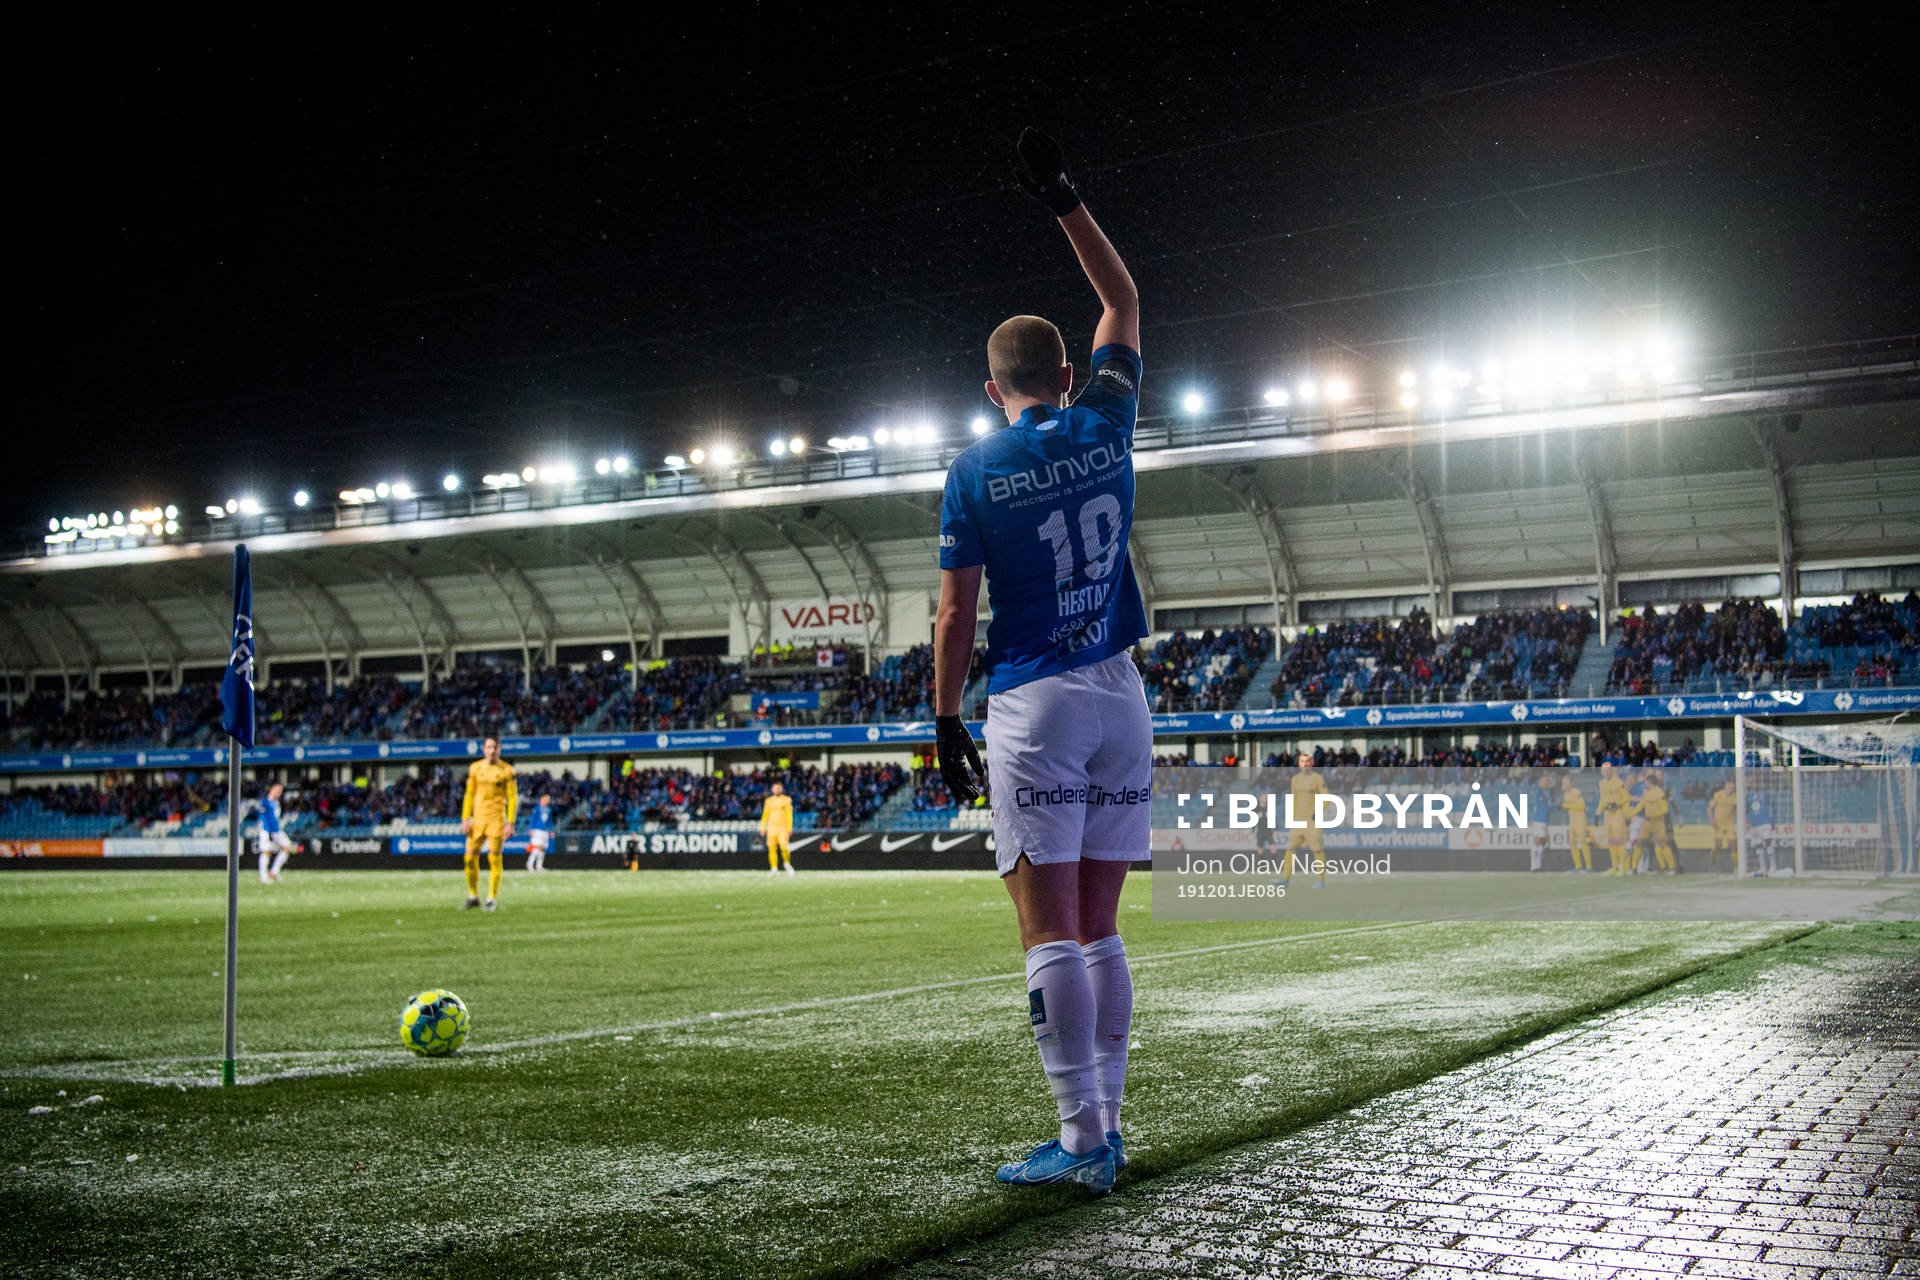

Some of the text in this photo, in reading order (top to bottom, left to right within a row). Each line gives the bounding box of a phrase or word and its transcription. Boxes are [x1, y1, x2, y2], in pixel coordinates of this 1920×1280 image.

[987, 436, 1133, 503] BRUNVOLL
[1009, 489, 1060, 510] PRECISION
[1063, 487, 1073, 496] IS
[1076, 480, 1095, 492] OUR
[782, 602, 875, 629] VARD
[1016, 784, 1087, 807] Cindere
[650, 834, 738, 854] STADION
[1360, 829, 1447, 847] workwear
[1485, 829, 1570, 848] Trianel
